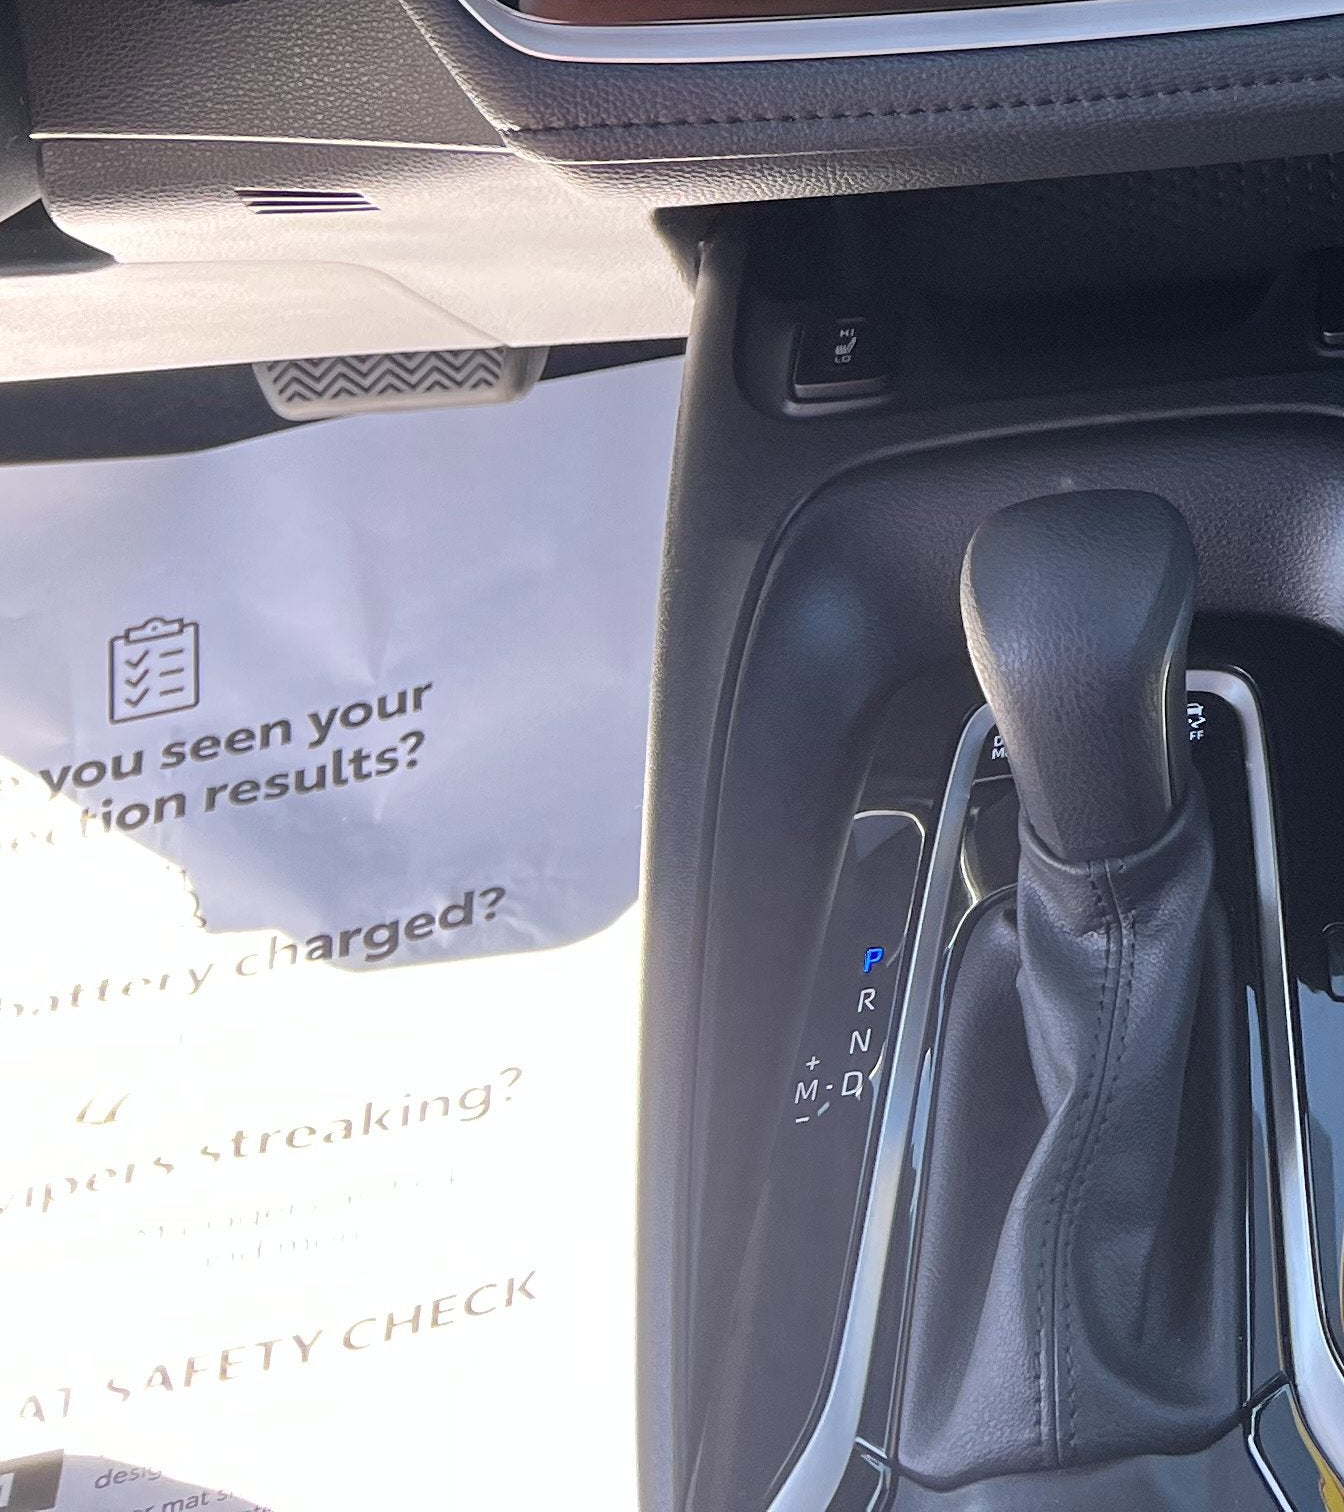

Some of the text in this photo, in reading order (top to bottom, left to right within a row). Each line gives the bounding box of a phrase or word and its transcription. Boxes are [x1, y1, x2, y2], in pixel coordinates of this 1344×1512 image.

[839, 329, 855, 337] HI
[37, 681, 433, 798] you seen your
[1189, 730, 1204, 741] FF
[205, 730, 425, 812] results?
[235, 886, 507, 977] charged?
[863, 946, 885, 973] P
[857, 988, 876, 1013] R
[849, 1028, 872, 1055] N
[794, 1071, 863, 1104] M D
[19, 1270, 536, 1422] AT SAFETY CHECK
